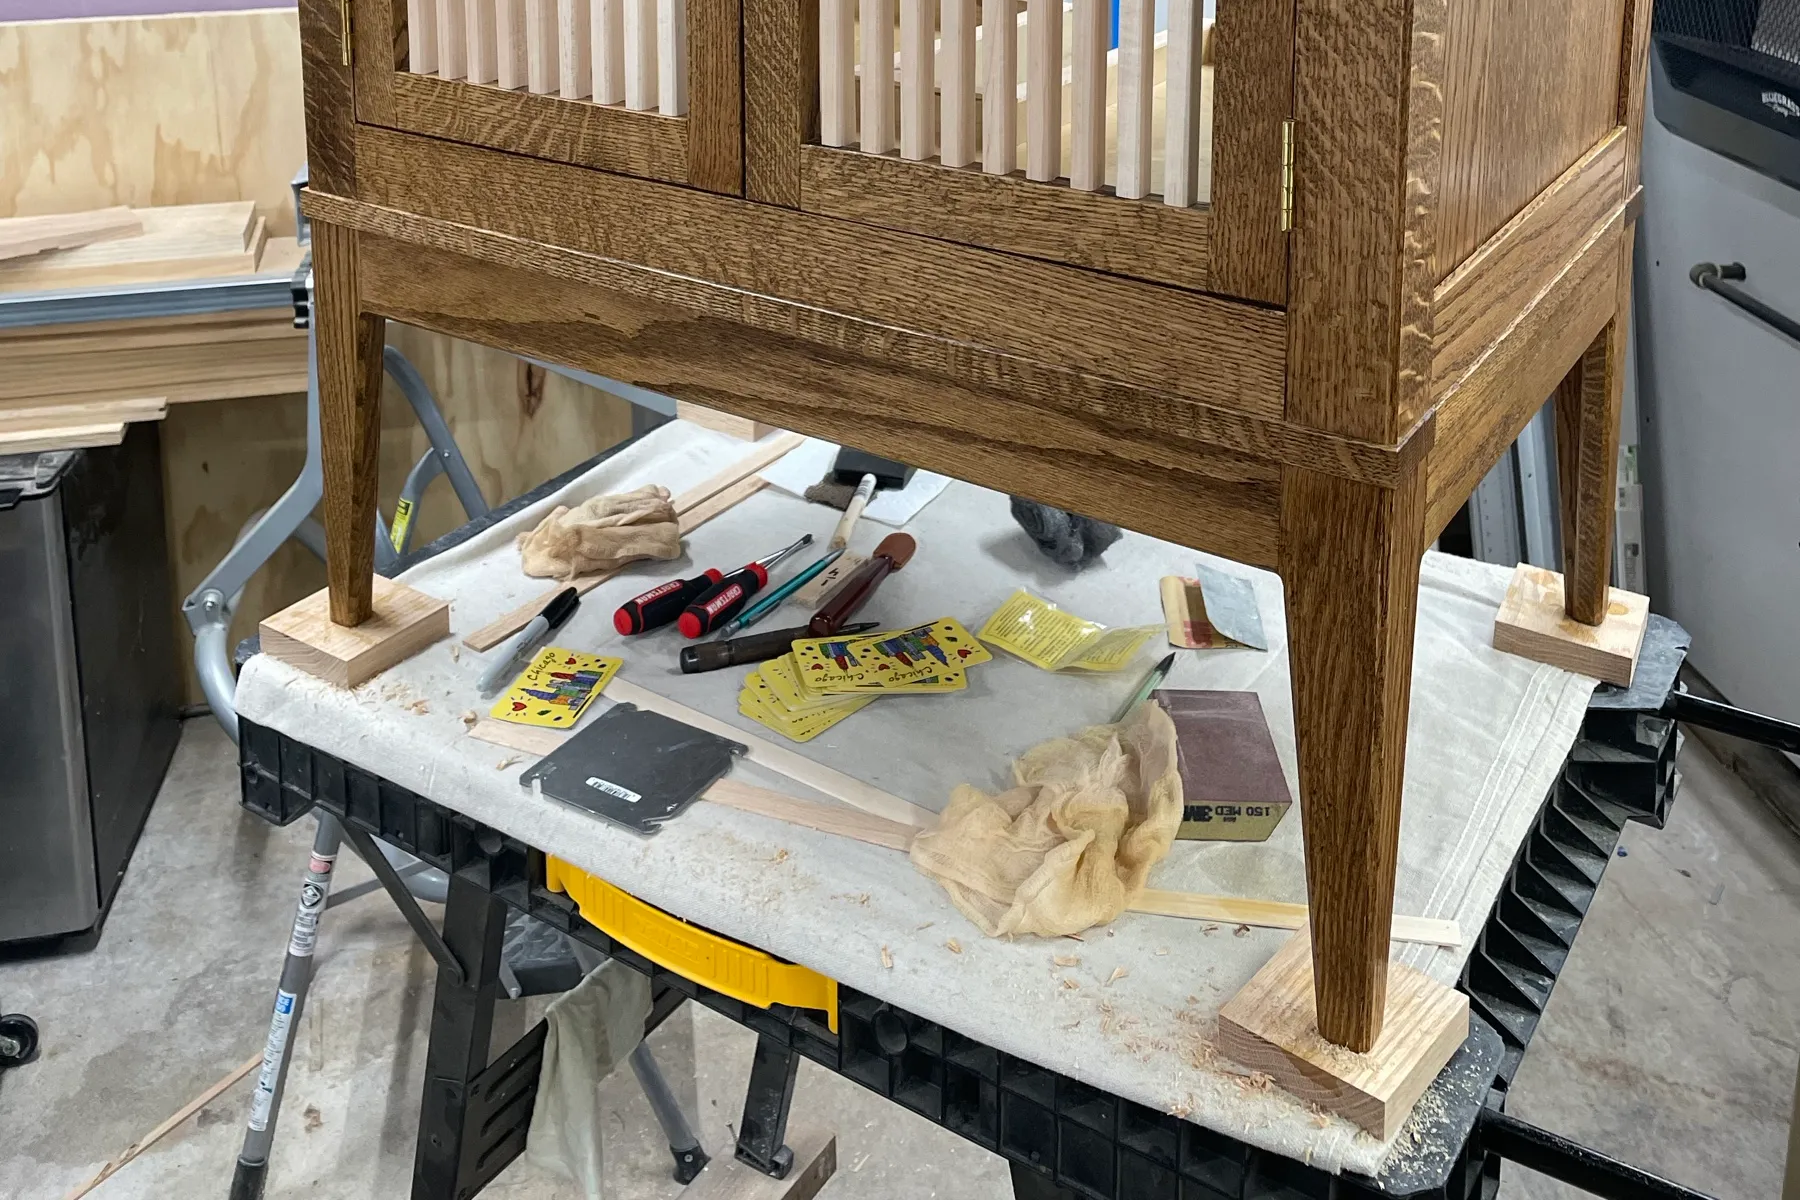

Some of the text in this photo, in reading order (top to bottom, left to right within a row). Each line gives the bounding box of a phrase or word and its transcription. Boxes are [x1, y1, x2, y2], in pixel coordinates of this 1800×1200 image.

[634, 581, 680, 605] CRAFTSMAN
[706, 585, 741, 614] CRAFTSMAN
[527, 652, 556, 681] Chicago
[889, 666, 932, 682] Chicago
[815, 673, 864, 683] Chicago
[1183, 805, 1212, 822] 3M
[1215, 805, 1270, 817] 150 MED
